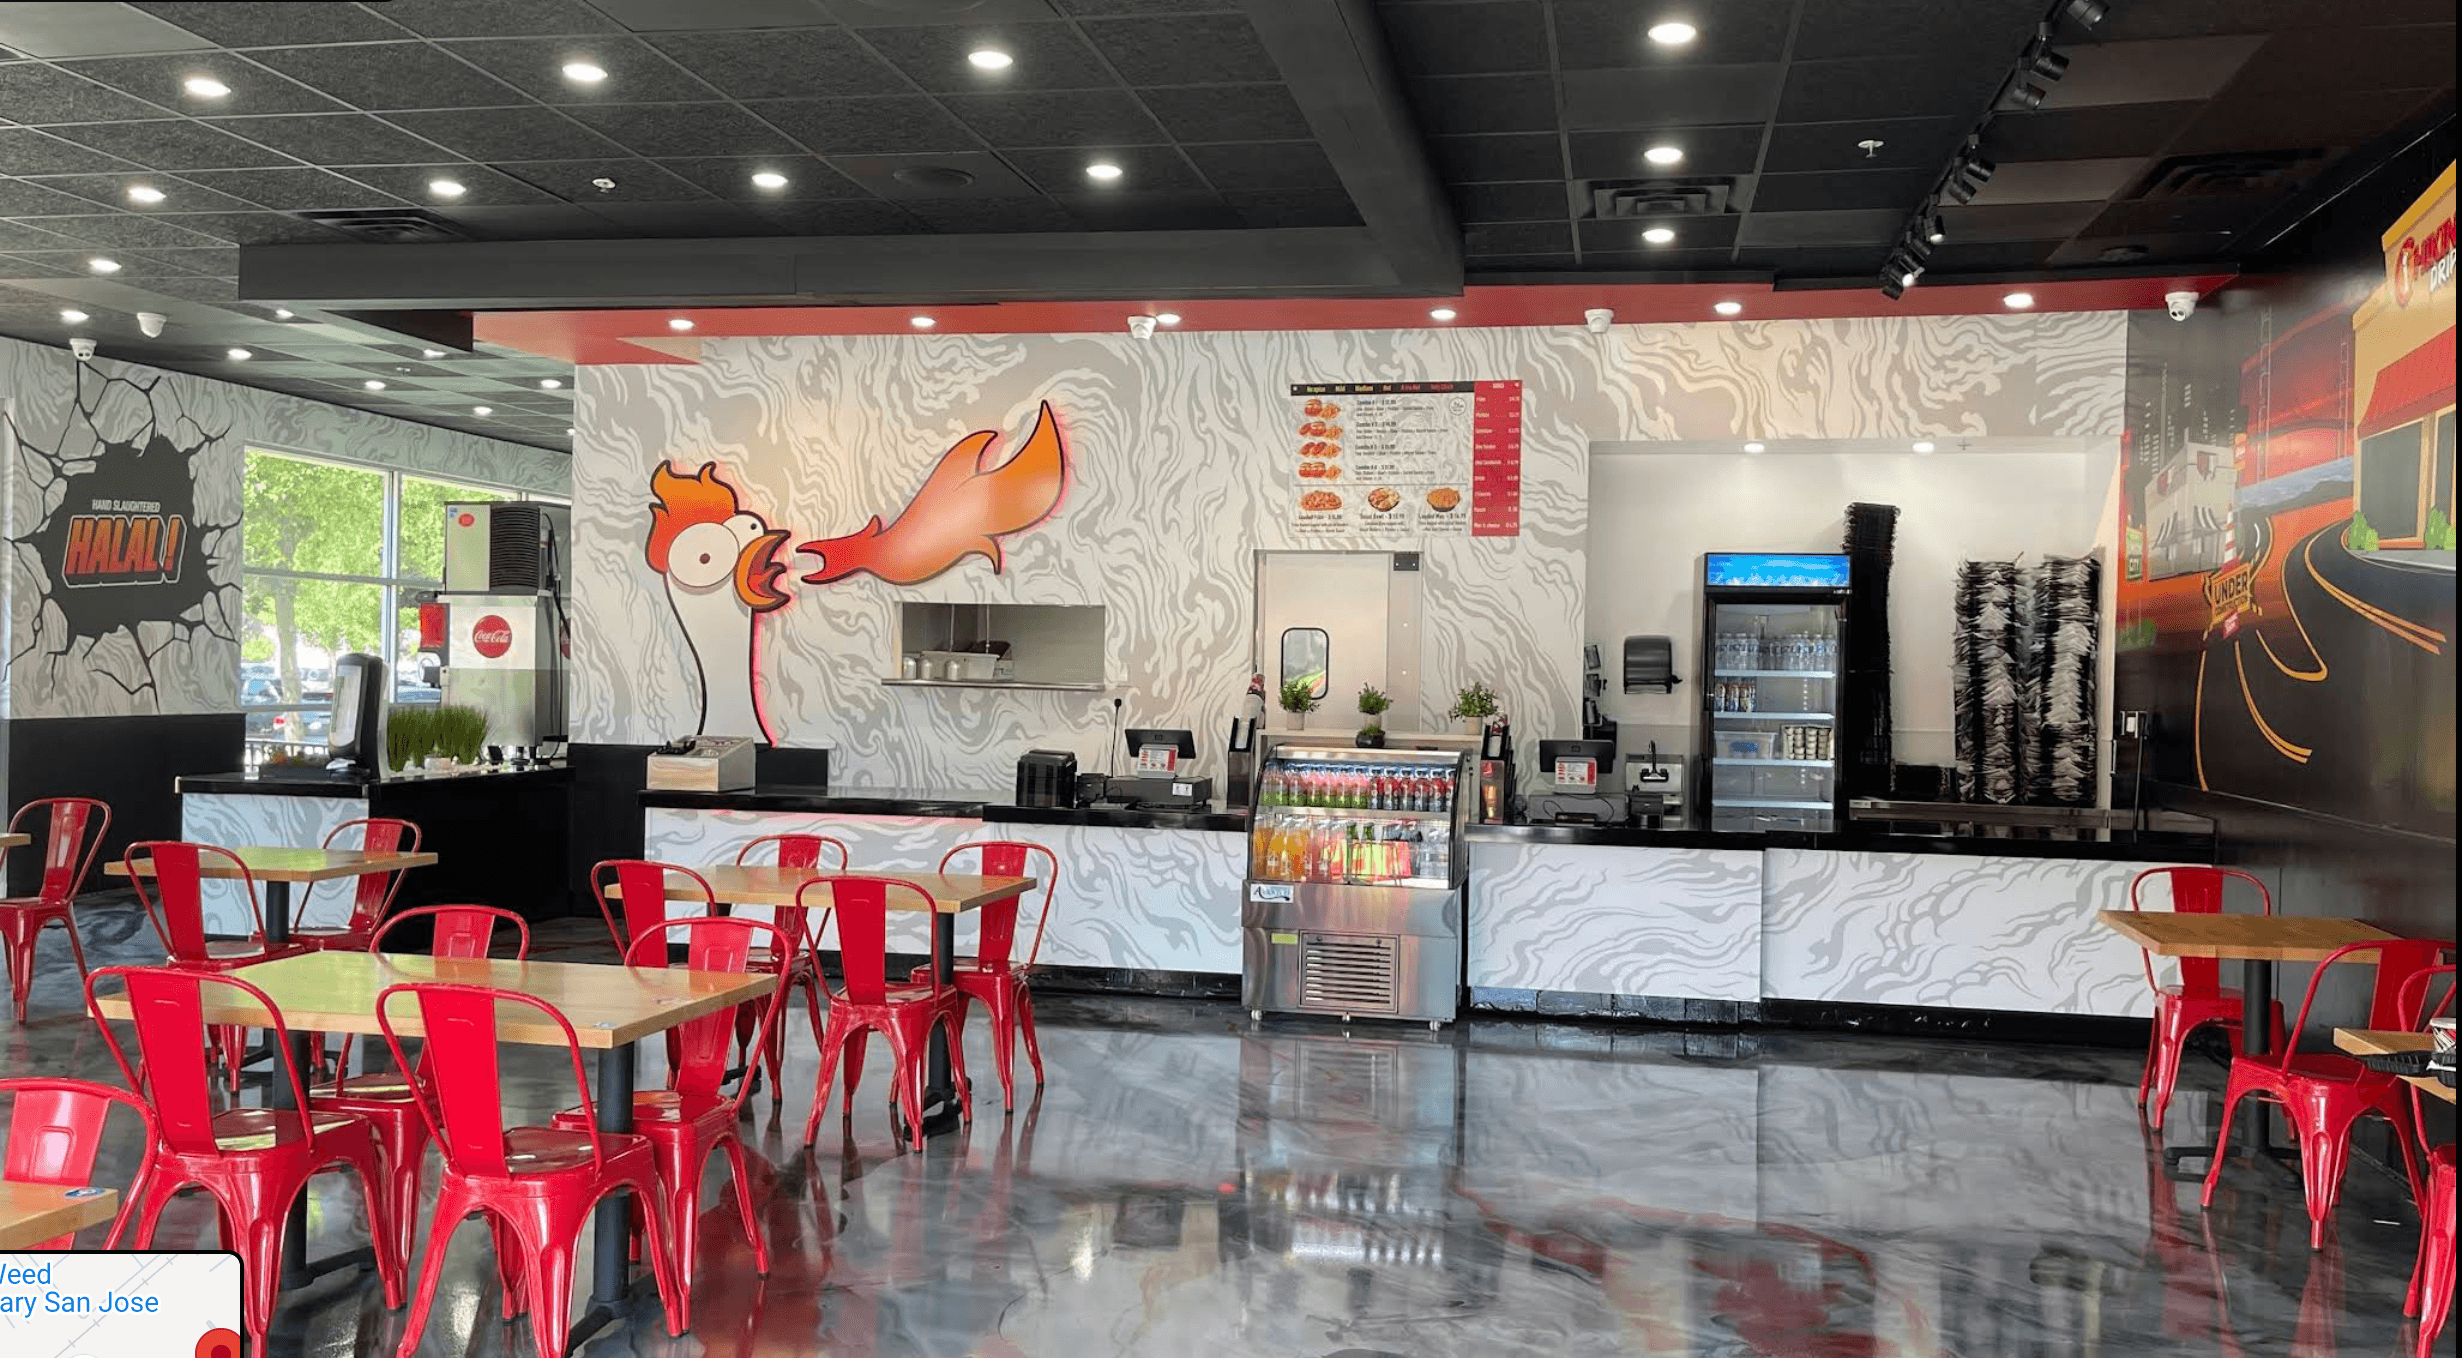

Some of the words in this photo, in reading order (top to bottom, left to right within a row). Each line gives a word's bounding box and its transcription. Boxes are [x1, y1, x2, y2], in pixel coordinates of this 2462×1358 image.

[2430, 248, 2456, 293] DRIP
[91, 499, 112, 511] HAND
[113, 500, 160, 513] SLAUGHTERED
[2213, 572, 2248, 605] UNDER
